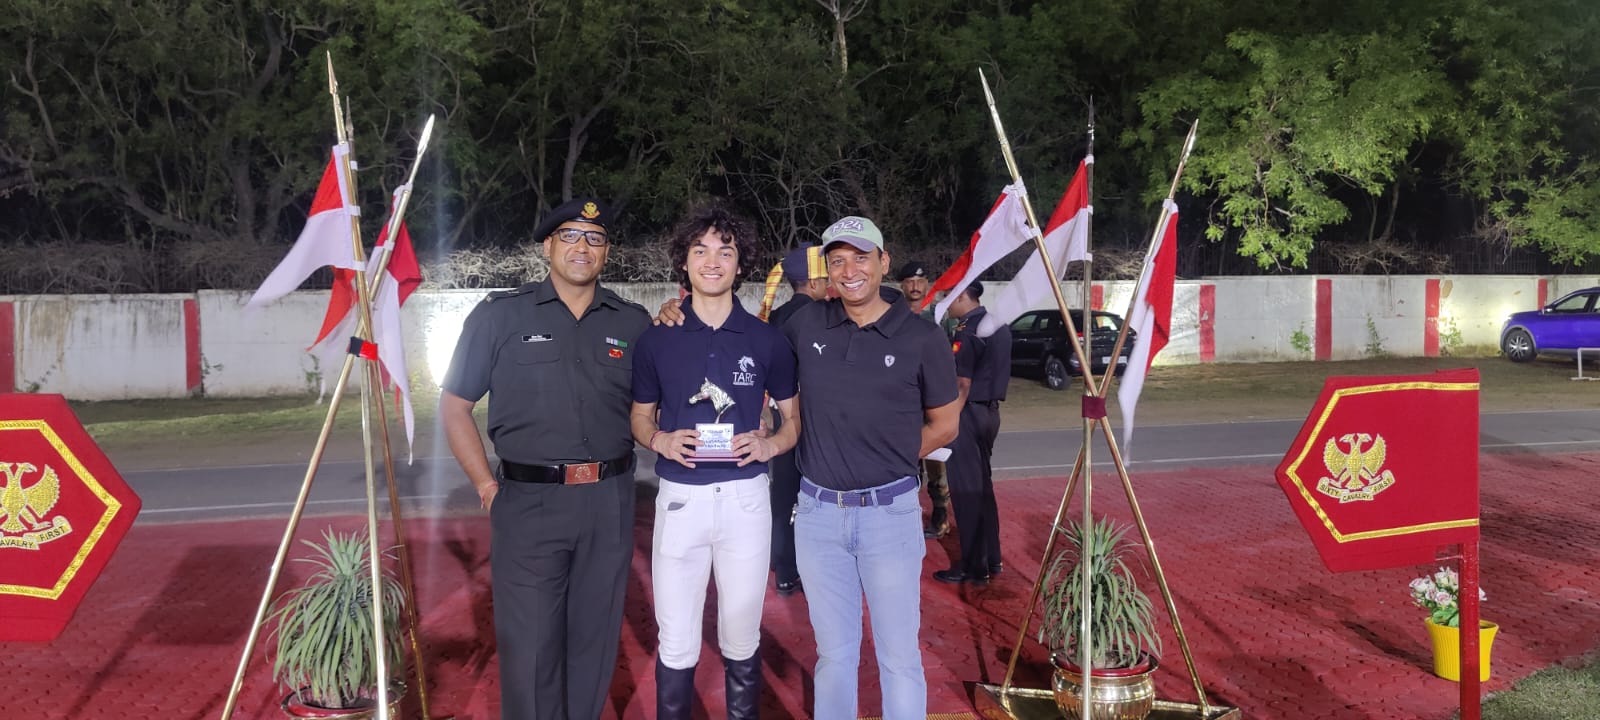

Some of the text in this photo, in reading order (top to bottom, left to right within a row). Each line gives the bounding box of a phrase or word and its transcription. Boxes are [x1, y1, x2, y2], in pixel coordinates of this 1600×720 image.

[732, 372, 757, 383] TARC
[1320, 484, 1339, 497] SIXTY
[1373, 477, 1391, 492] FIRST
[39, 525, 66, 542] FIRST
